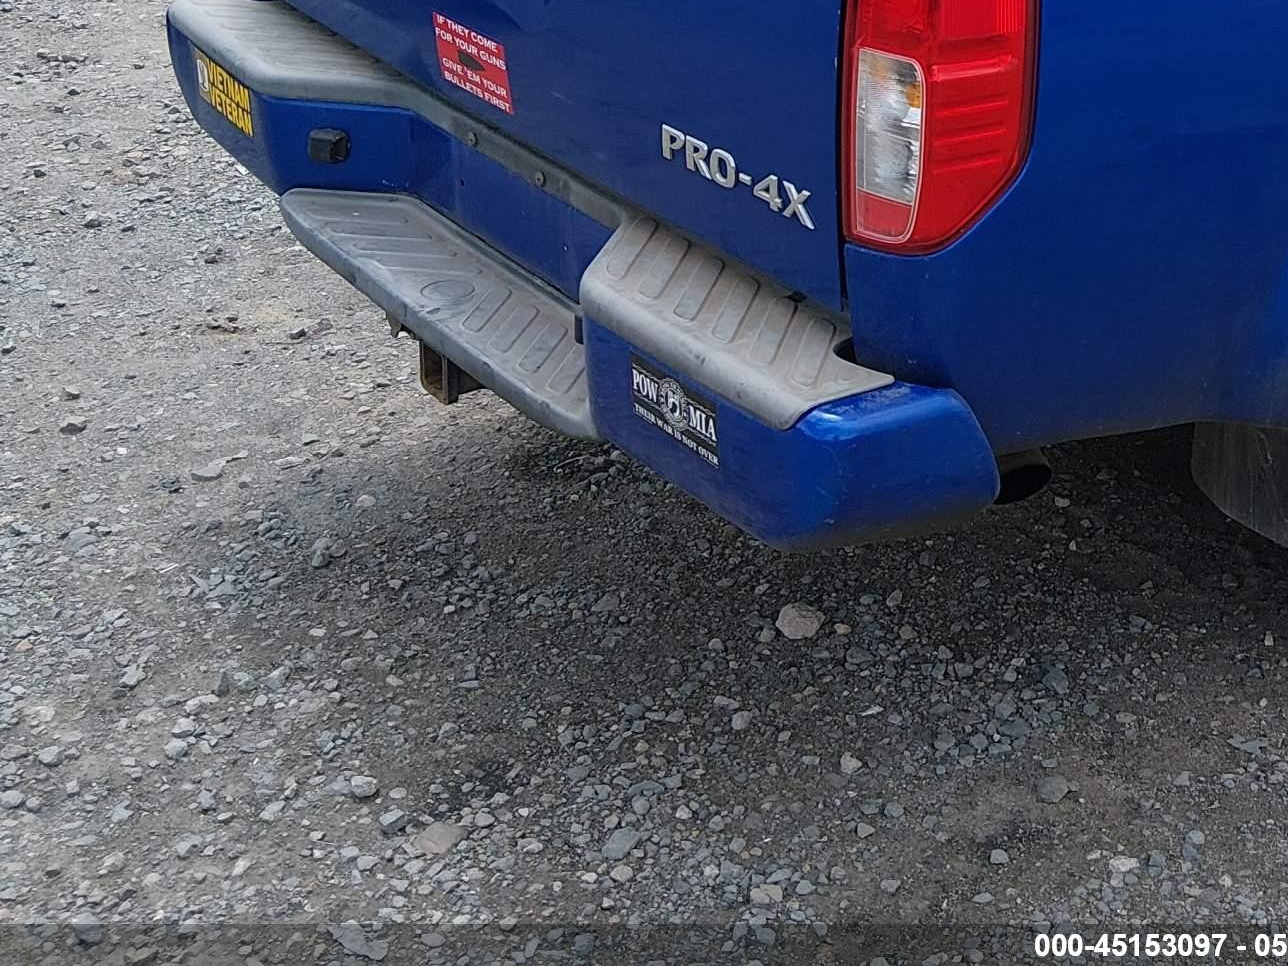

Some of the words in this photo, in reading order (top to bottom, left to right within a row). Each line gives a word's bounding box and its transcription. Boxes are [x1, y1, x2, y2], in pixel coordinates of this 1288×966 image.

[435, 27, 453, 43] FOR
[454, 37, 478, 57] YOUR
[480, 51, 506, 70] GUNS
[436, 14, 445, 25] IF
[446, 19, 469, 37] THEY
[471, 31, 498, 52] COME
[208, 60, 251, 113] VIETNAM
[442, 58, 464, 75] GIVE
[464, 67, 480, 84] 'EM
[482, 77, 507, 98] YOUR
[444, 71, 483, 98] BULLETS
[484, 92, 511, 113] FIRST
[209, 82, 253, 137] VETERAN
[660, 123, 816, 230] PRO-4X
[632, 368, 659, 402] POW
[688, 405, 717, 441] MIA
[634, 403, 656, 424] THEIR
[656, 418, 673, 435] WAR
[674, 430, 682, 441] IS
[682, 434, 698, 450] NOT
[698, 446, 719, 465] OVER
